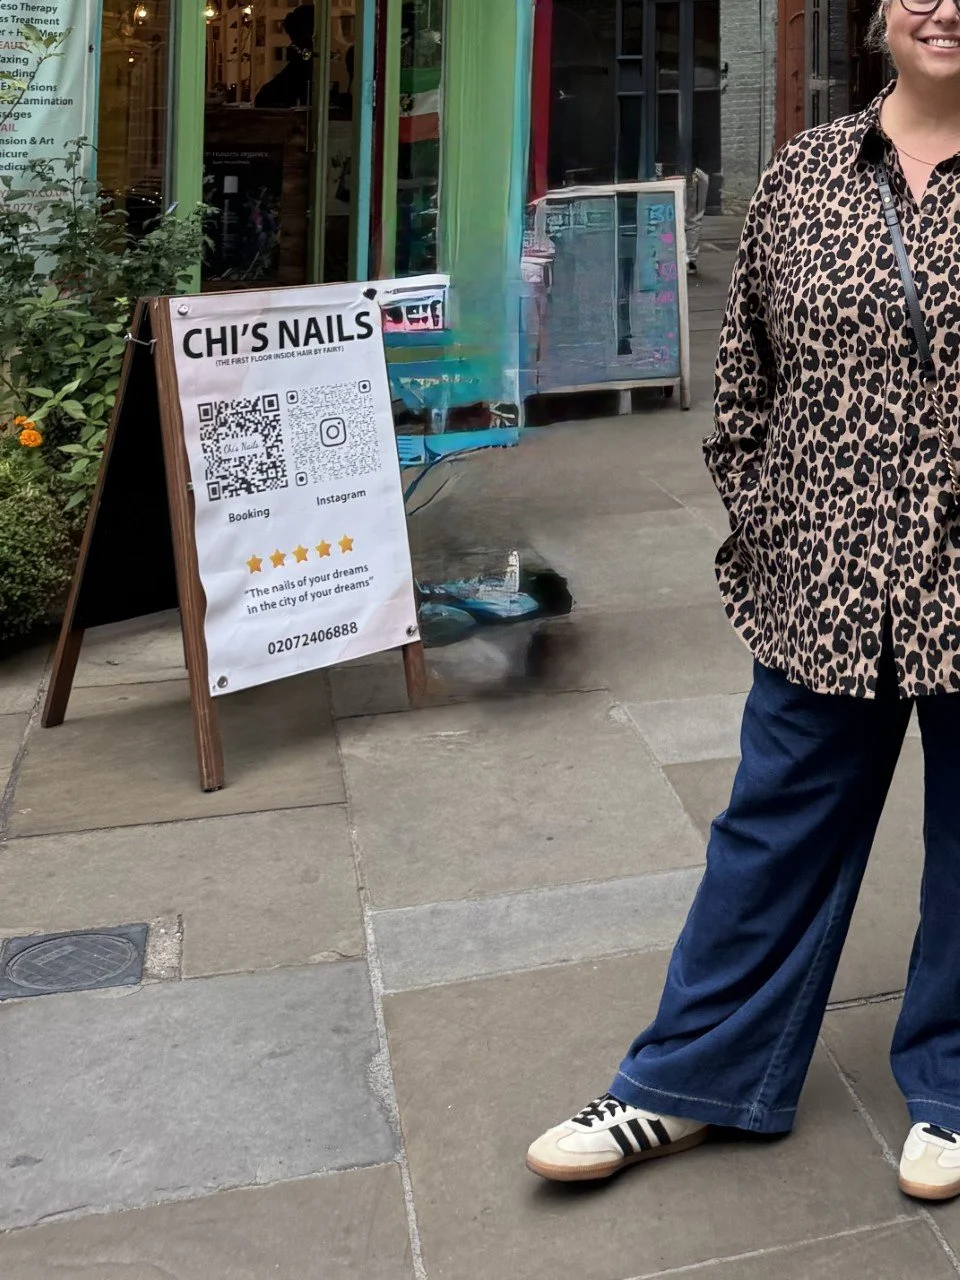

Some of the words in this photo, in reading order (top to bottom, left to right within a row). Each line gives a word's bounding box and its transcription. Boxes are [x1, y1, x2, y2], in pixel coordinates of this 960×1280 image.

[20, 2, 58, 14] Therapy
[11, 15, 60, 26] Treatment
[0, 57, 29, 66] axing
[18, 97, 74, 106] Lamination
[29, 136, 38, 145] &
[39, 137, 55, 145] Art
[183, 321, 269, 359] CHI'S
[278, 311, 374, 349] NAILS
[215, 358, 231, 367] (THE
[231, 356, 249, 365] FIRST
[251, 354, 273, 363] FLOOR
[273, 351, 296, 360] INSIDE
[296, 348, 313, 357] HAIR
[314, 347, 322, 355] BY
[323, 345, 345, 354] FAIRY)
[316, 489, 366, 506] Instagram
[228, 507, 270, 523] Booking
[271, 581, 296, 593] nails
[297, 576, 307, 587] of
[309, 573, 331, 587] your
[332, 564, 369, 579] dreams
[247, 605, 258, 615] in
[260, 600, 277, 612] the
[279, 596, 297, 608] city
[298, 591, 308, 602] of
[310, 588, 332, 602] your
[267, 621, 358, 655] 02072406888
